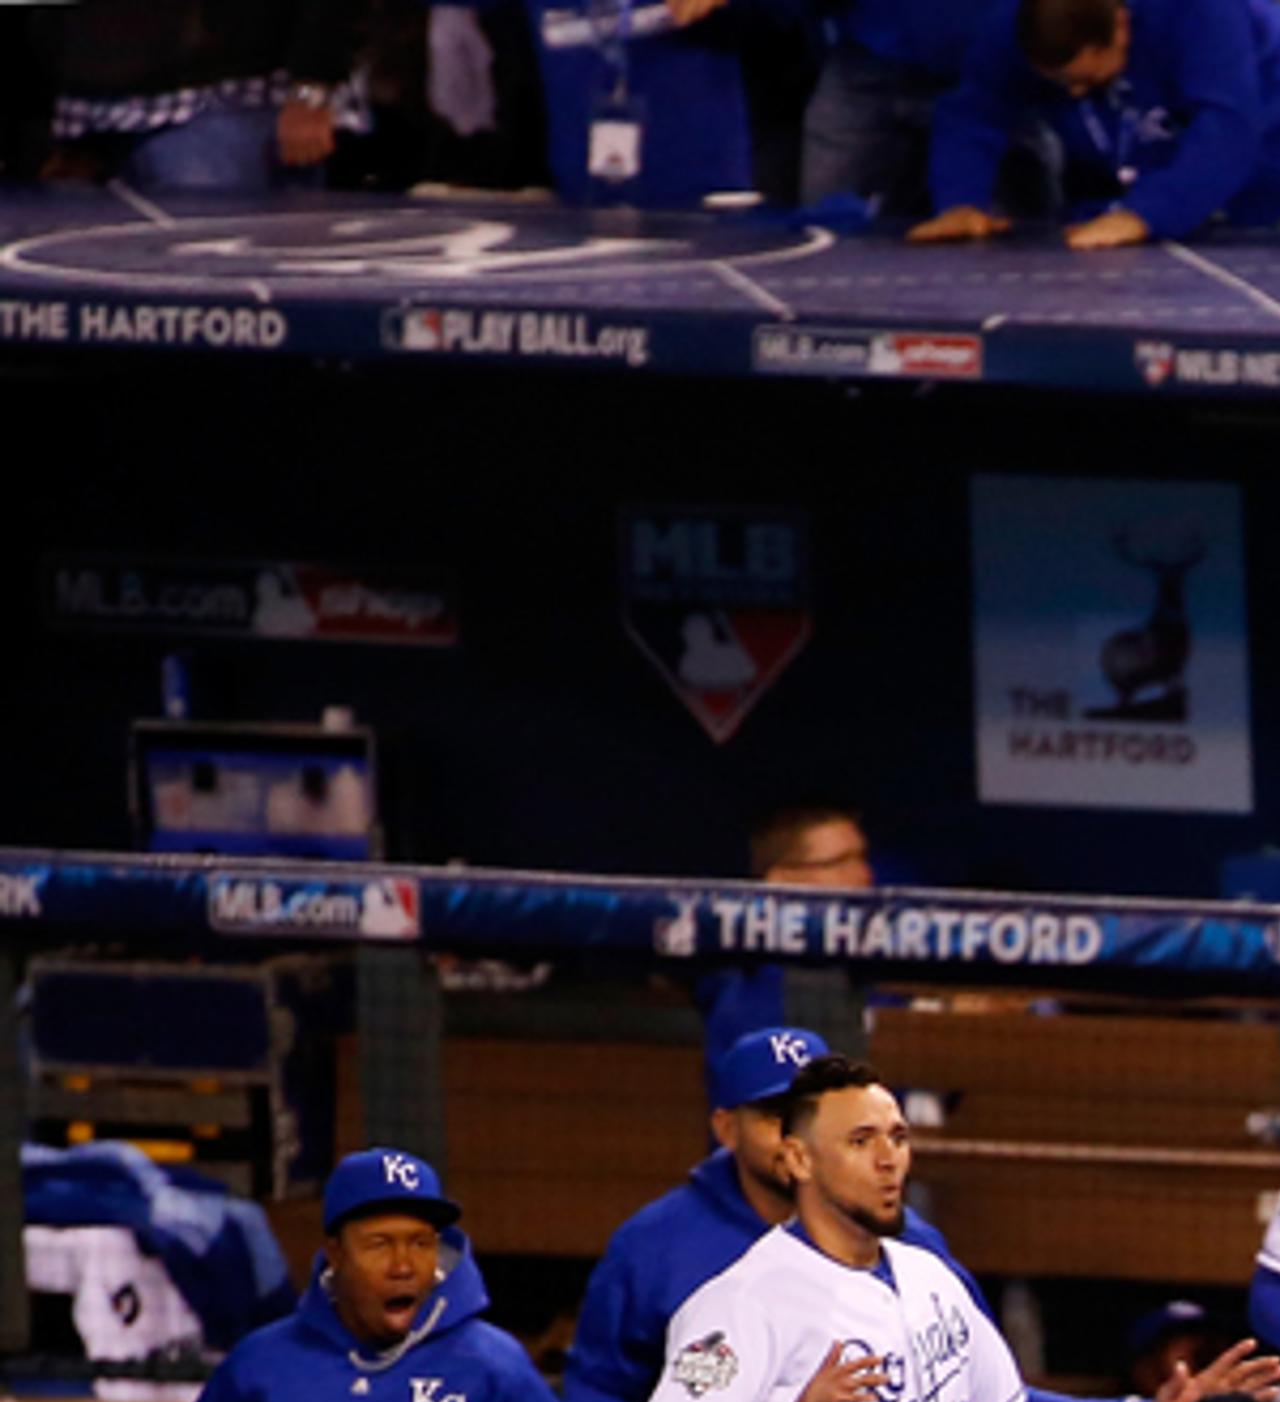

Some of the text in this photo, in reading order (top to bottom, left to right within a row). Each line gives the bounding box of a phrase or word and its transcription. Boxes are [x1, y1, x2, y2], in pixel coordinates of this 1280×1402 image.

[2, 303, 287, 349] THE HARTFORD
[1175, 351, 1238, 384] MLB
[631, 516, 797, 580] MLB
[55, 569, 248, 623] MLB.com
[1009, 688, 1071, 722] THE
[1009, 731, 1195, 766] HARTFORD
[213, 877, 360, 926] MLB.com
[713, 900, 1103, 964] THE HARTFORD
[770, 1033, 810, 1068] KC
[382, 1154, 419, 1190] KC
